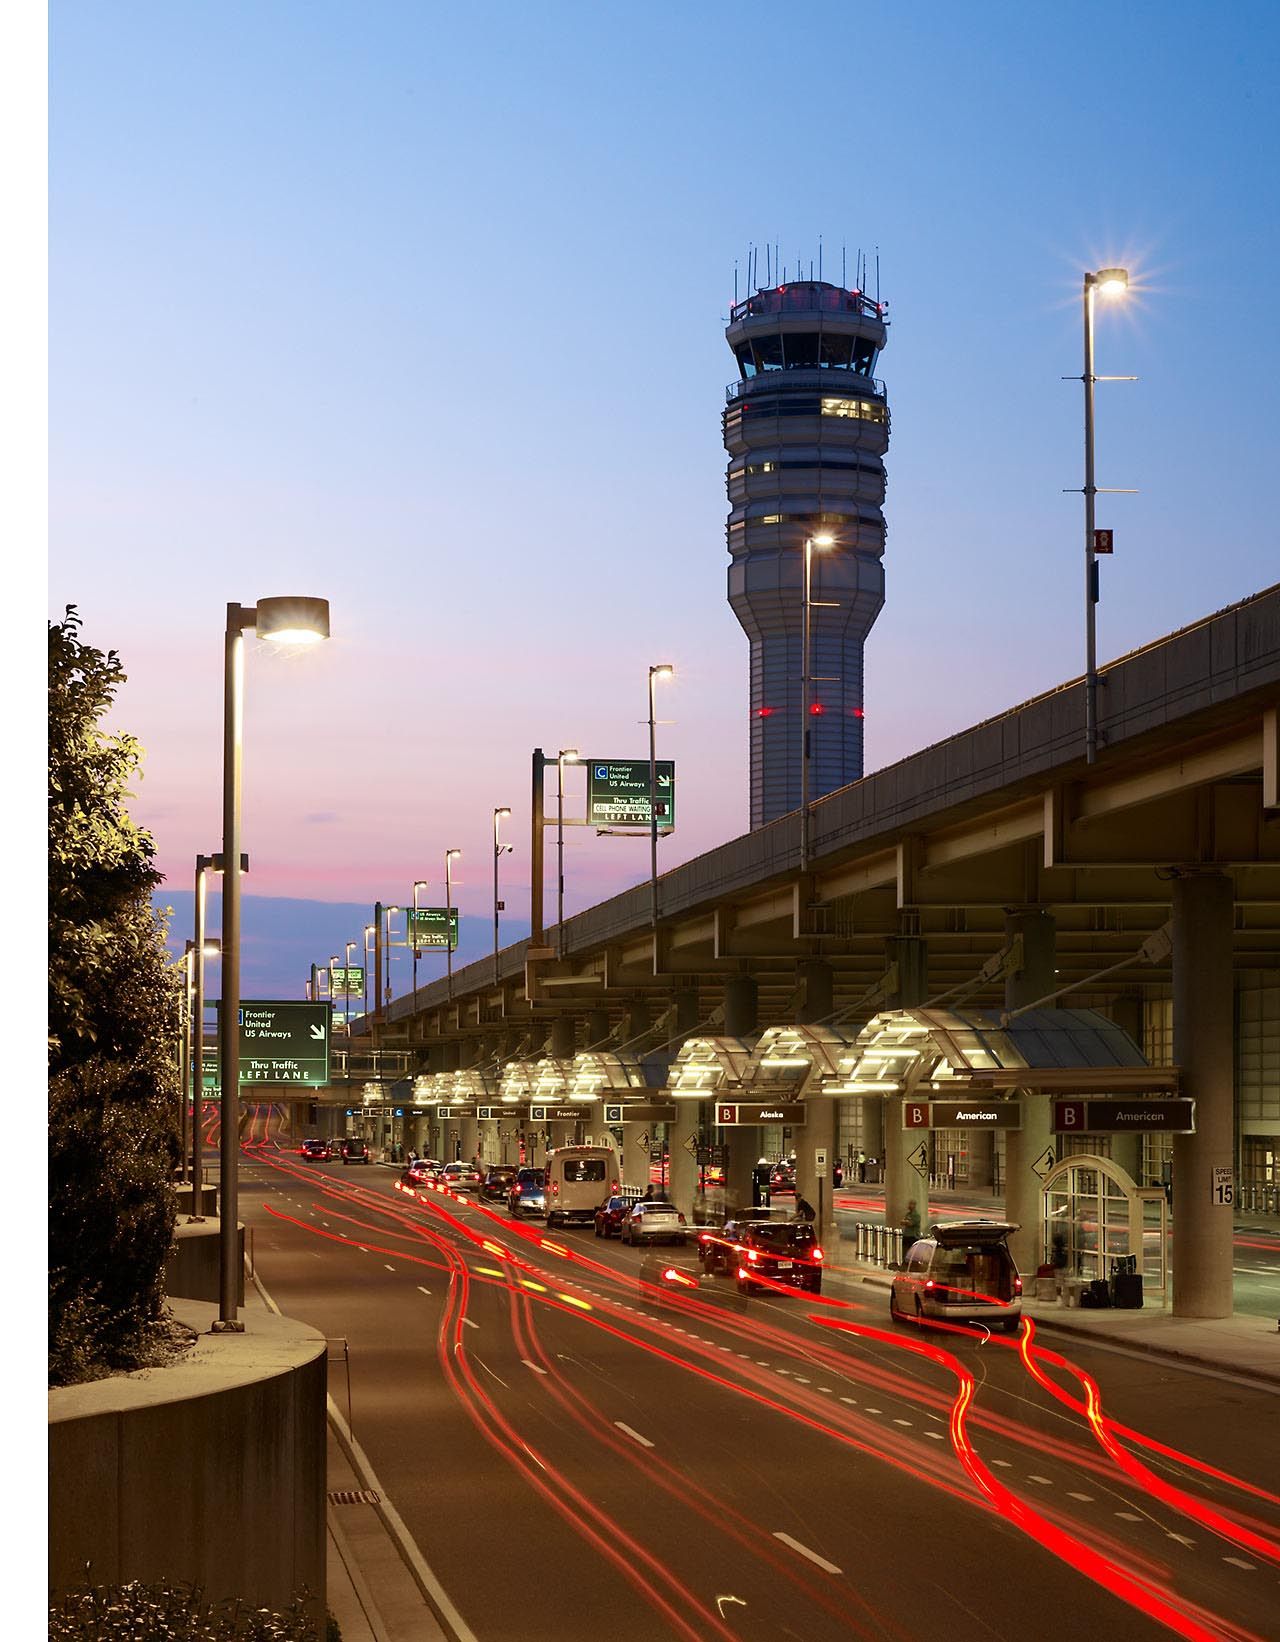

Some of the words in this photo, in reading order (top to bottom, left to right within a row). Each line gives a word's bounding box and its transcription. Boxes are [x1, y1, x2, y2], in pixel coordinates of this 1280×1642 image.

[597, 767, 606, 777] C
[628, 805, 651, 813] WAITING
[245, 1010, 276, 1018] Frontier
[245, 1020, 271, 1028] United
[245, 1030, 256, 1038] US
[258, 1030, 292, 1039] Airways
[250, 1061, 269, 1069] Thru
[271, 1061, 299, 1069] Traffic
[239, 1070, 269, 1079] LEFT
[275, 1071, 309, 1079] LANE
[480, 1109, 488, 1117] C
[534, 1109, 543, 1118] C
[609, 1109, 618, 1119] C
[723, 1109, 731, 1120] B
[913, 1108, 922, 1123] B
[956, 1111, 998, 1120] American
[1064, 1107, 1076, 1125] B
[1116, 1111, 1165, 1121] American
[1215, 1184, 1233, 1204] 15
